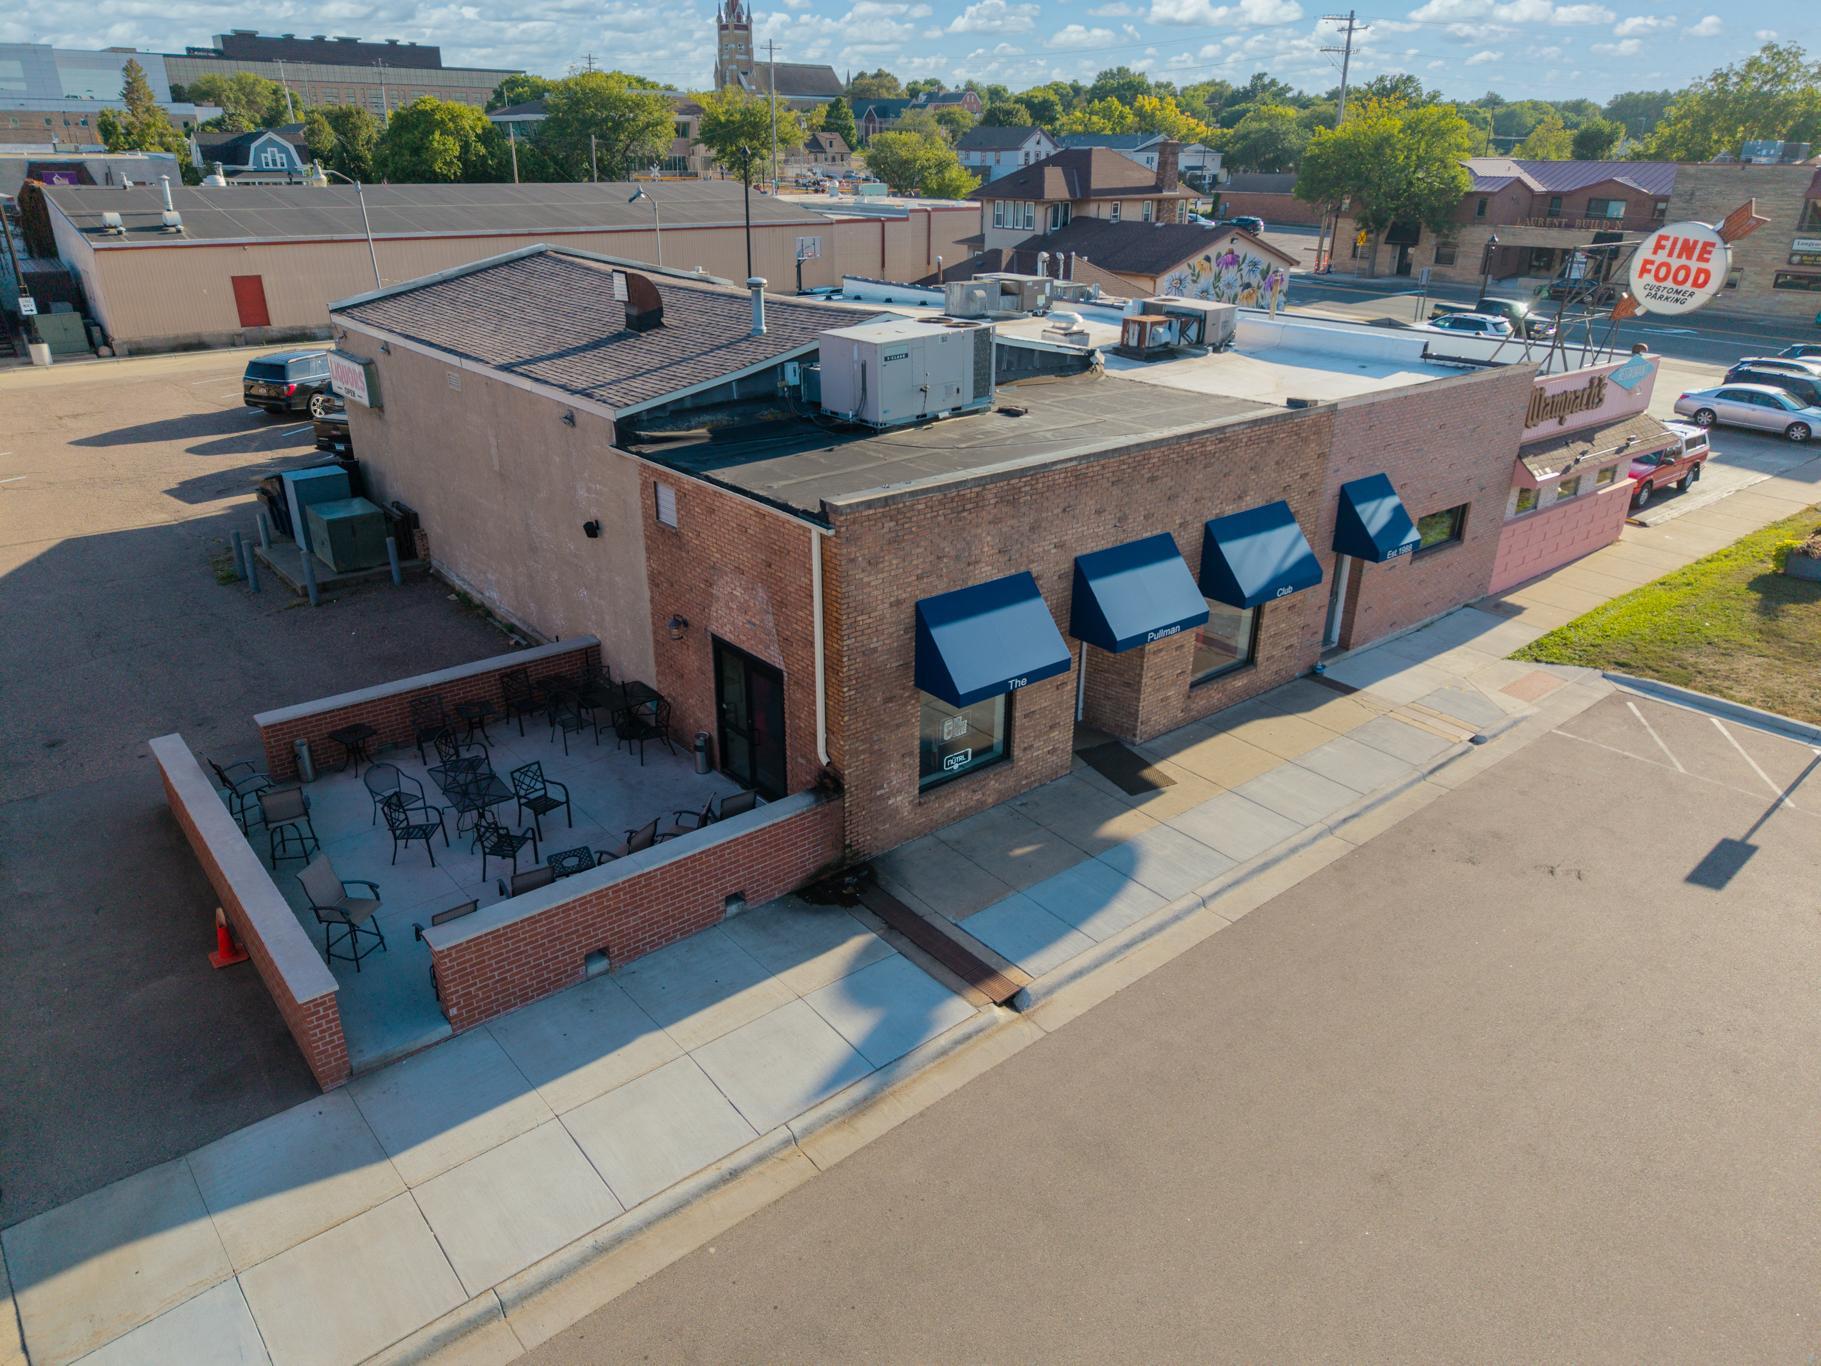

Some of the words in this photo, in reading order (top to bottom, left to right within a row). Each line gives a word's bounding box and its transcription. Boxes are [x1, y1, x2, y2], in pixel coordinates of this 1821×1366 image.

[1516, 216, 1569, 228] LAURENT
[1651, 234, 1716, 263] FINE
[1638, 259, 1711, 289] FOOD
[1643, 283, 1696, 298] CUSTOMER
[1645, 291, 1688, 305] PARKING
[330, 358, 366, 394] LIQUORS
[1276, 585, 1293, 598] Club
[1147, 625, 1181, 642] Pullman
[1007, 677, 1028, 690] The
